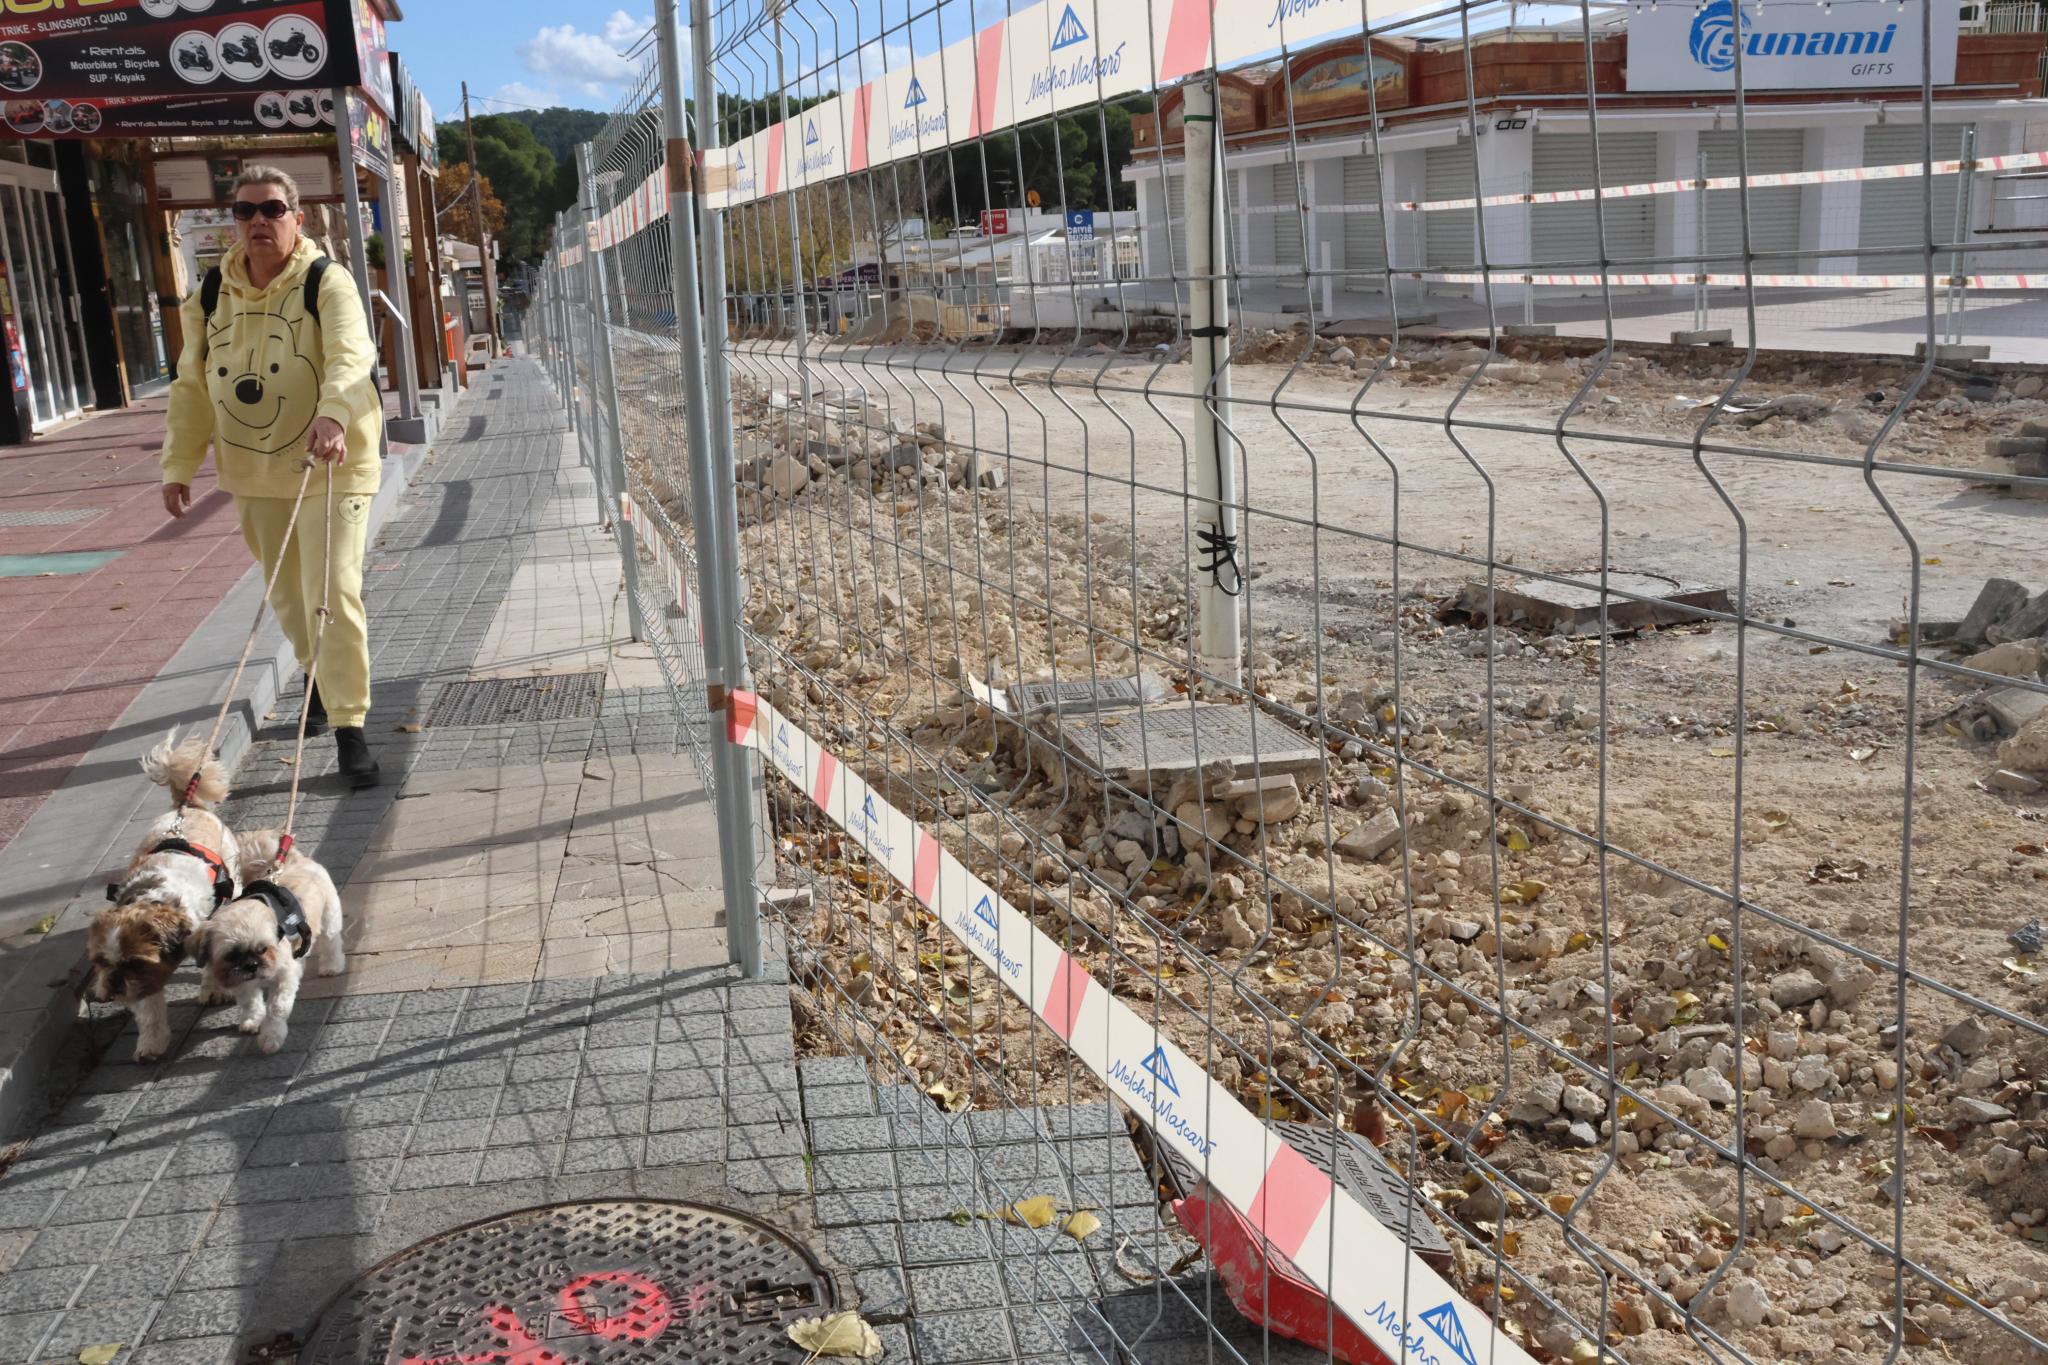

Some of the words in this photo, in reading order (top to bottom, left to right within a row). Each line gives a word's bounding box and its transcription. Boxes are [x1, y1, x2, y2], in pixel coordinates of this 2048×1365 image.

[2, 24, 30, 36] TRIKE
[37, 16, 92, 32] SLINGSHOT
[99, 12, 128, 24] QUAD
[90, 46, 146, 56] Rentals
[70, 61, 118, 70] Motorbikes
[124, 59, 160, 70] Bicycles
[1851, 63, 1894, 76] GIFTS
[89, 73, 108, 83] SUP
[115, 72, 145, 84] Kayaks
